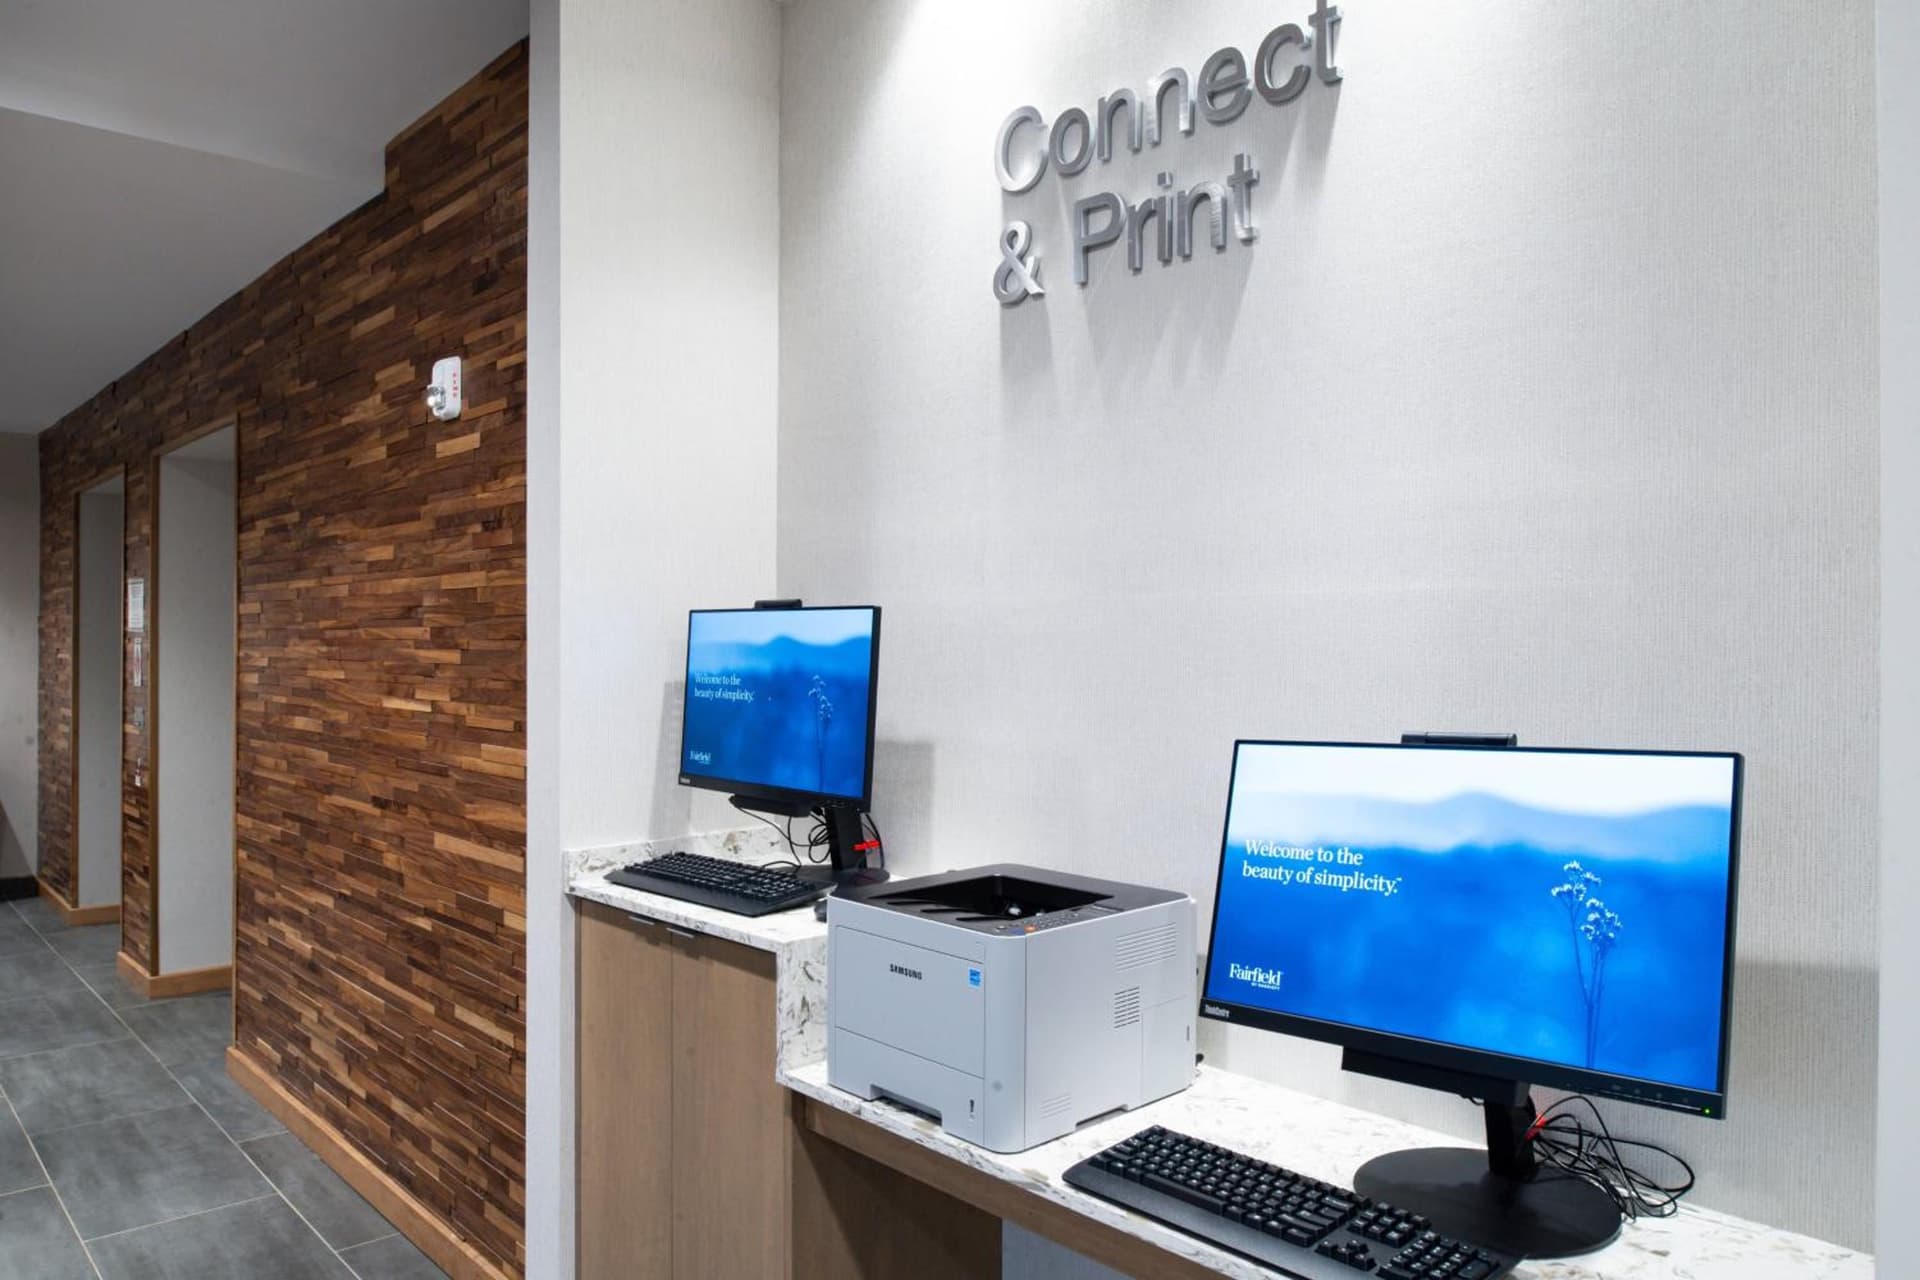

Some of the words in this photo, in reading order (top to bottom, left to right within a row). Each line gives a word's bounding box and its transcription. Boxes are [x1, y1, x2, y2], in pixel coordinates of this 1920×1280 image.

[993, 0, 1343, 192] Connect
[993, 220, 1045, 306] &
[1073, 153, 1260, 285] Print
[1245, 840, 1314, 860] Welcome
[1317, 847, 1333, 863] to
[1337, 846, 1364, 866] the
[1242, 860, 1294, 885] beauty
[1296, 867, 1315, 884] of
[890, 963, 922, 980] SAMSUNG
[1229, 963, 1280, 986] Fairfield
